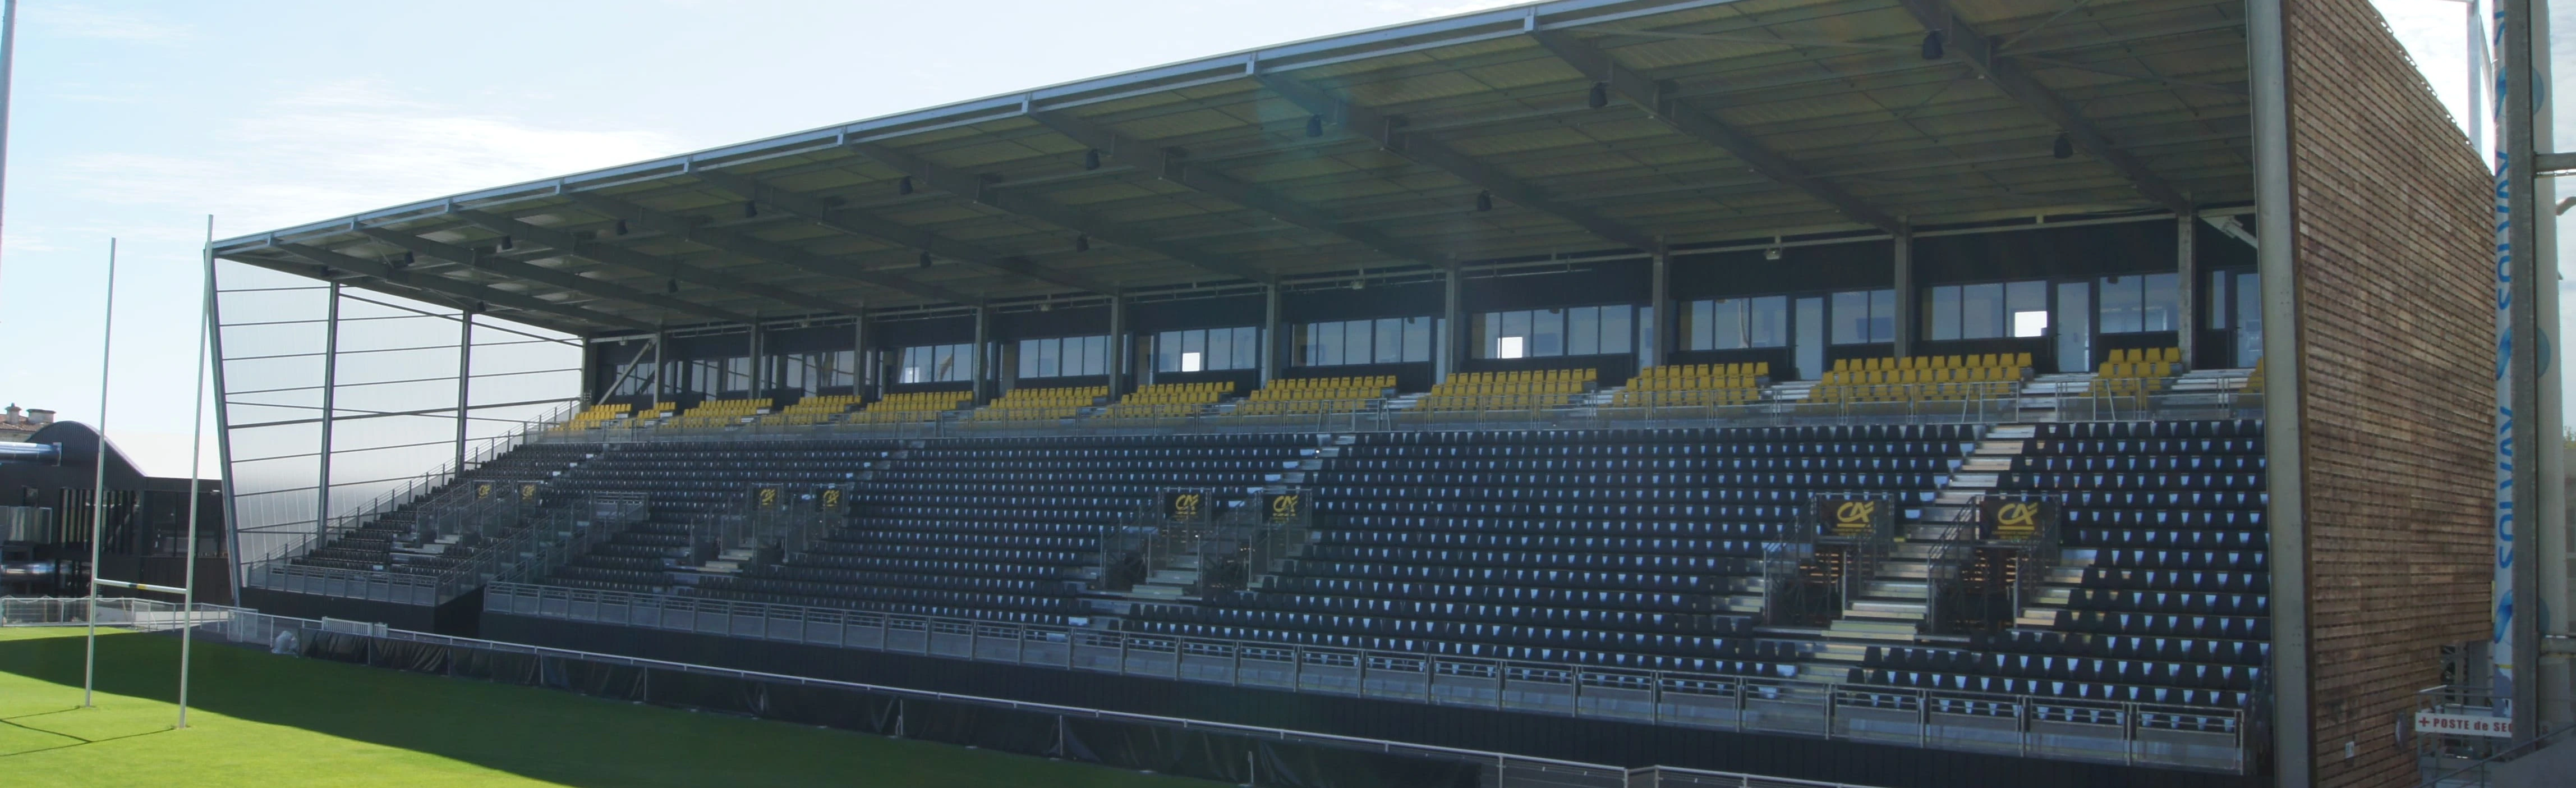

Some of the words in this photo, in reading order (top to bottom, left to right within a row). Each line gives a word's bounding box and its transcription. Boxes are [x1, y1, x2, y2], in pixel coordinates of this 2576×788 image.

[1837, 501, 1875, 523] CA
[1998, 502, 2038, 525] CA
[2433, 718, 2469, 729] POSTE
[2474, 721, 2488, 731] de
